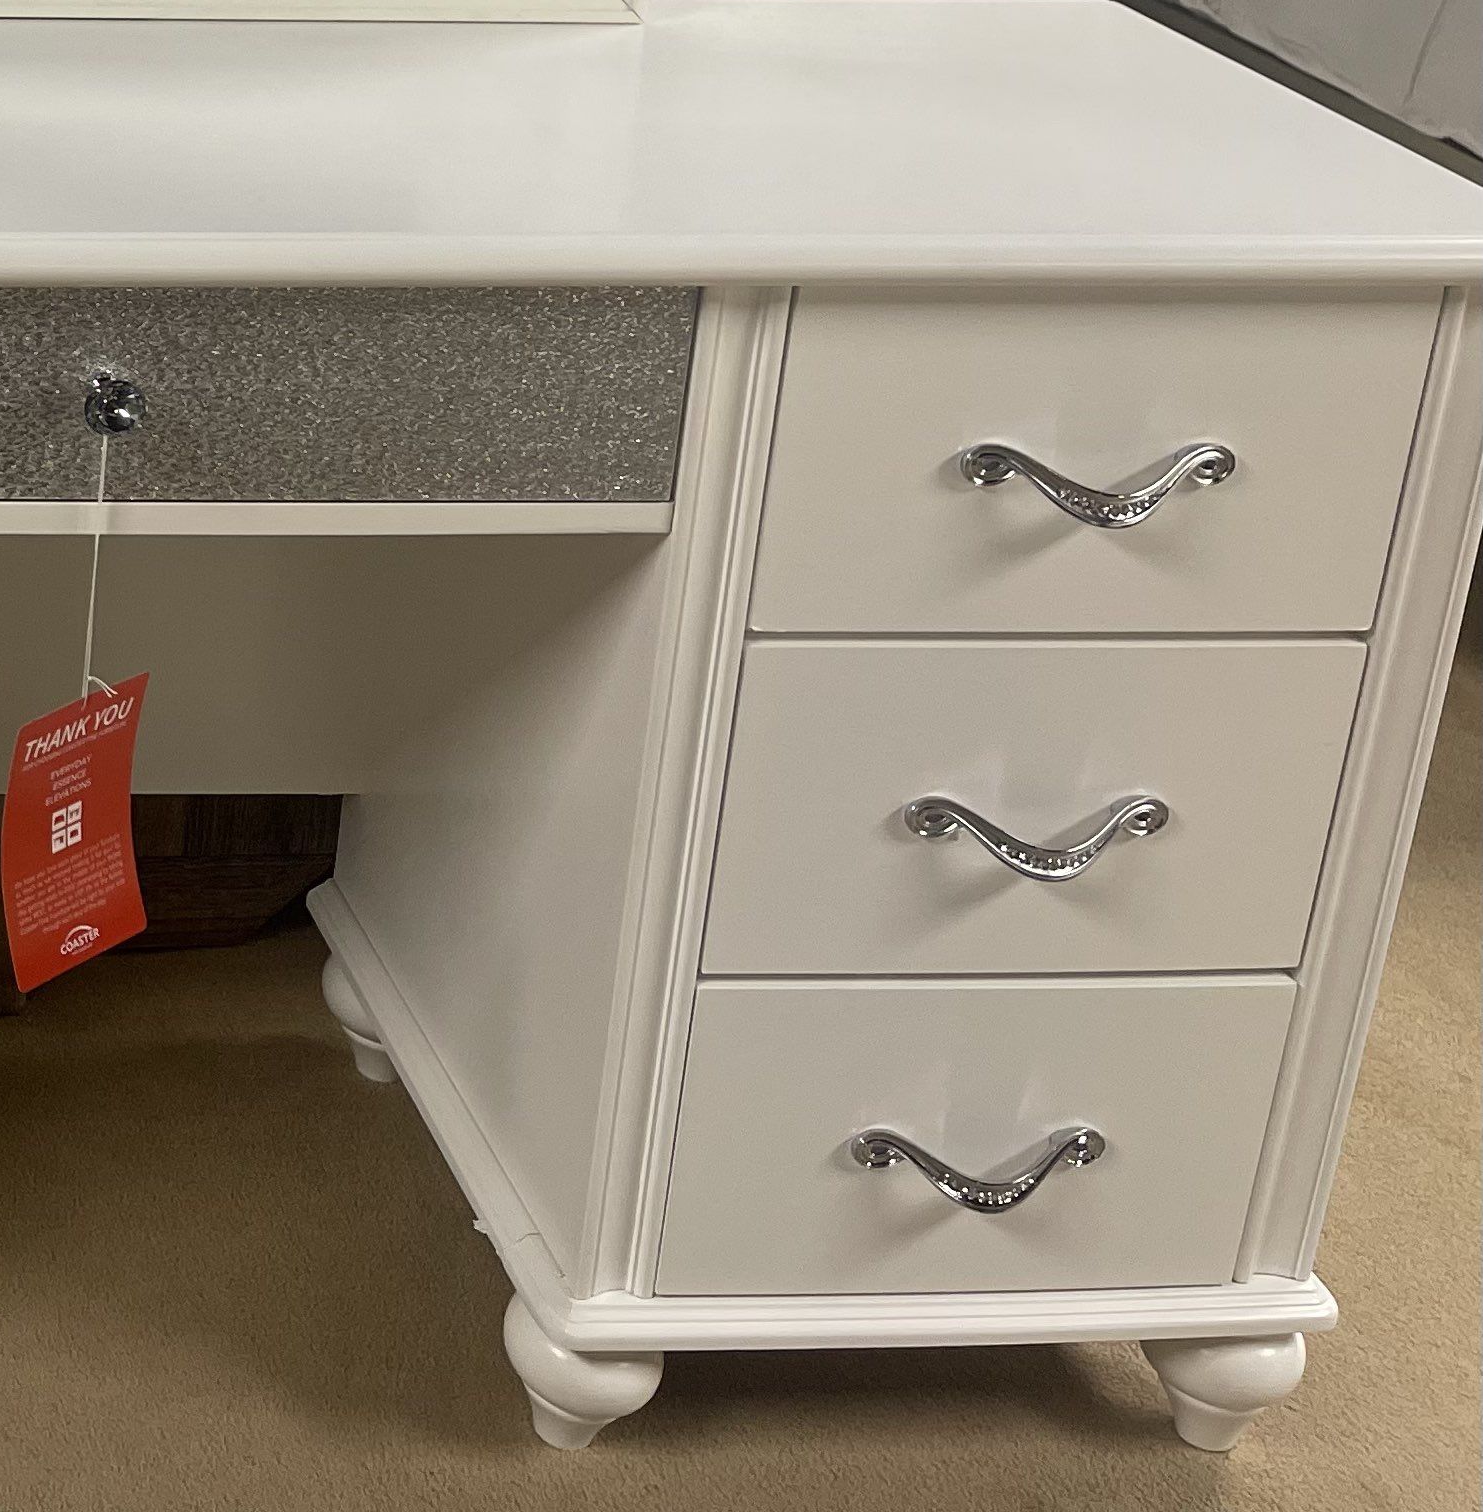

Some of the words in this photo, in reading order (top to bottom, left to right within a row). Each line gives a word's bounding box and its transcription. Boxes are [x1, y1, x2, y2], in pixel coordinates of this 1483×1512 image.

[24, 714, 91, 762] THANK
[93, 696, 134, 731] YOU
[50, 753, 92, 780] EVERYDAY
[52, 768, 87, 791] ESSENCE
[44, 778, 92, 807] ELEVATIONS
[60, 926, 101, 955] COASTER
